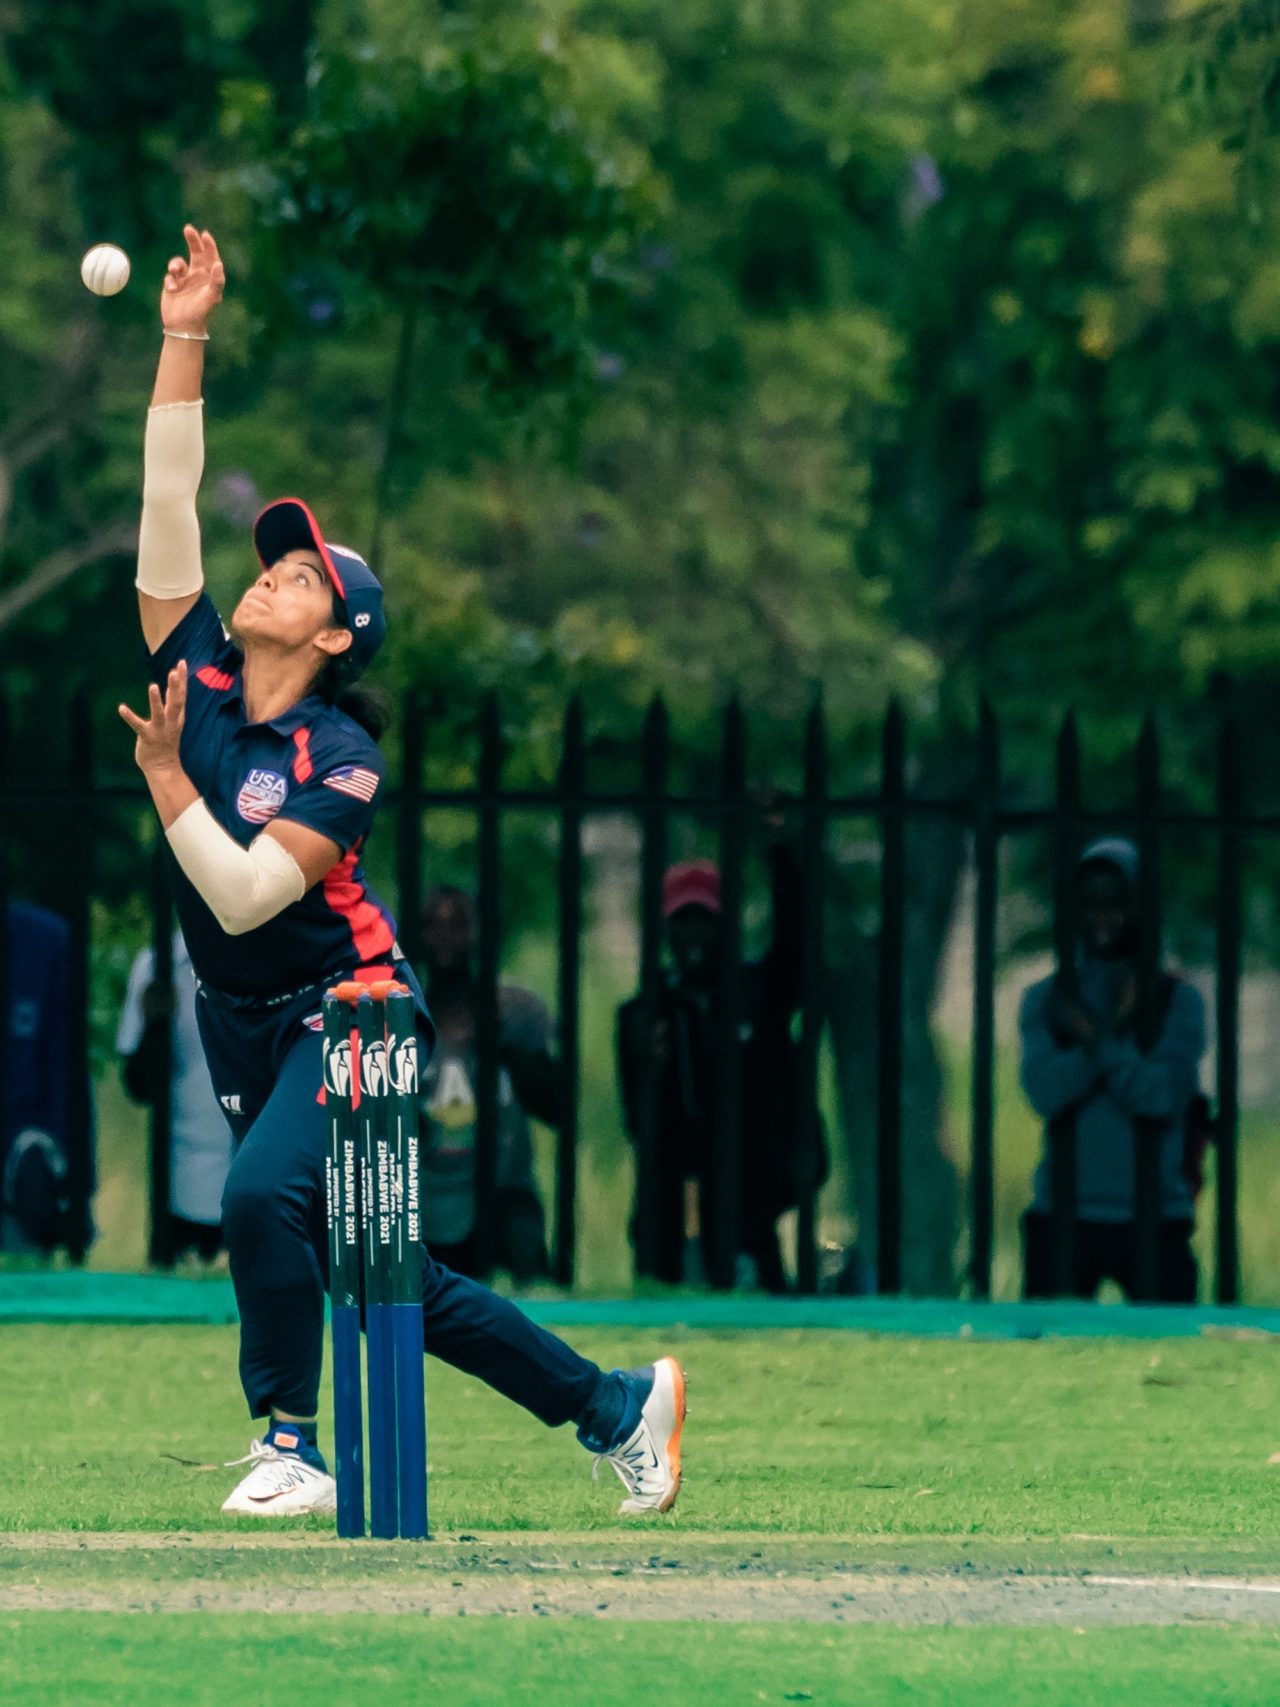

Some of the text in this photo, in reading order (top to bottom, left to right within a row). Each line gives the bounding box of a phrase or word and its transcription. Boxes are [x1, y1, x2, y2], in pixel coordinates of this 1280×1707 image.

[248, 769, 286, 795] USA
[344, 1140, 355, 1245] ZIMBABWE 2021
[377, 1140, 390, 1244] ZIMBABWE 2021
[408, 1137, 418, 1241] ZIMBABWE 2021
